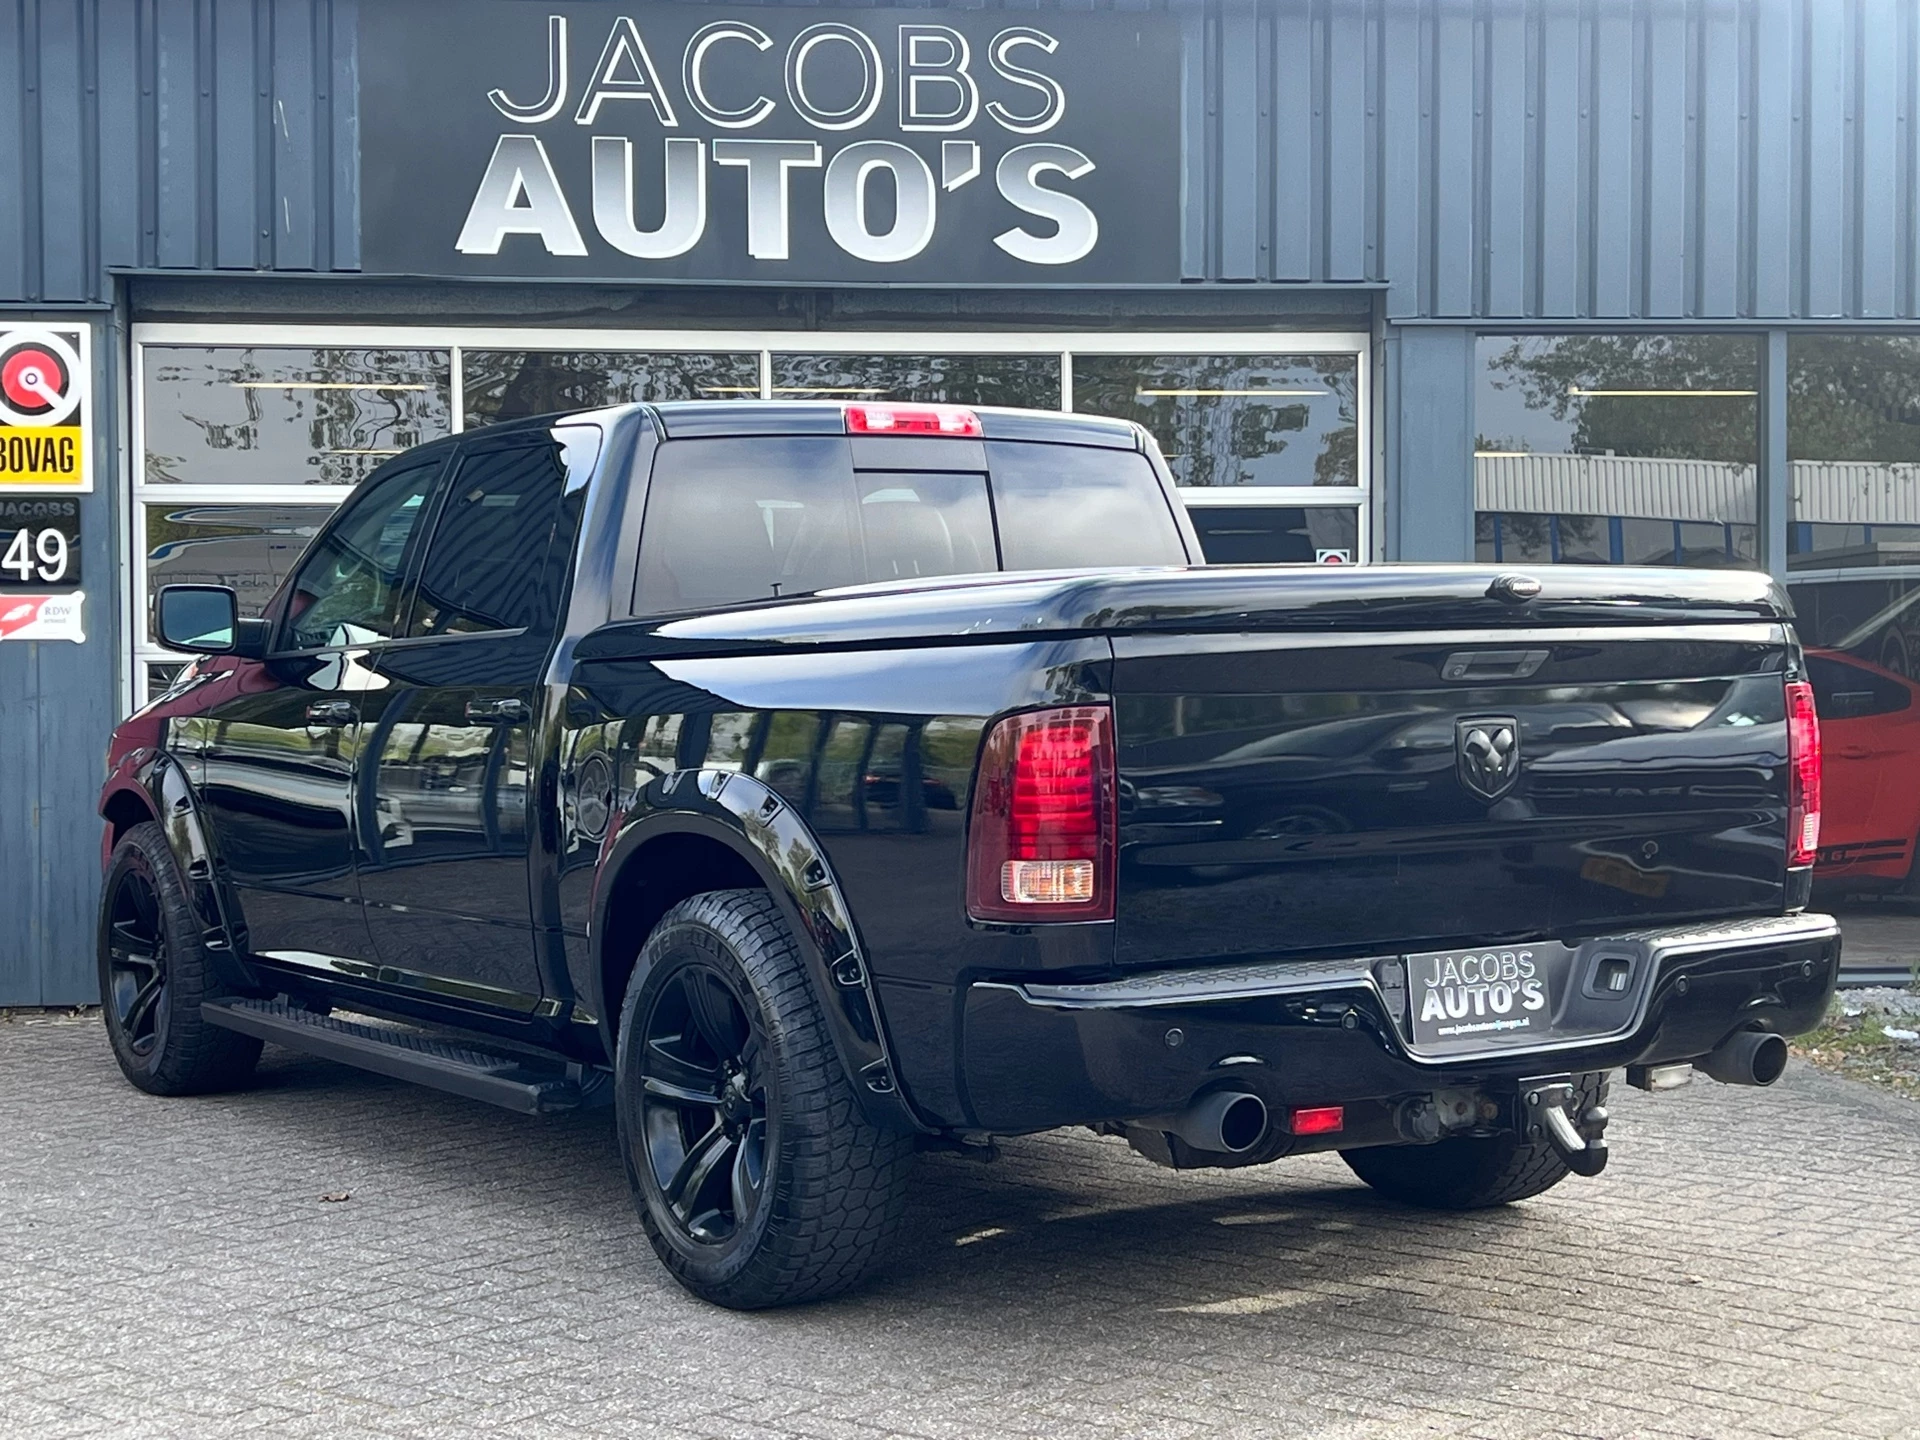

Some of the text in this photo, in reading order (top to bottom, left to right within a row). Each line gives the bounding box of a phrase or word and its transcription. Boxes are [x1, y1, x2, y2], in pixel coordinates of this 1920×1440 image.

[487, 15, 1065, 134] JACOBS
[455, 134, 1099, 264] AUTO'S
[1, 528, 68, 581] 49
[44, 606, 71, 615] RDW
[1424, 950, 1535, 987] JACOBS
[1420, 978, 1545, 1021] AUTO'S
